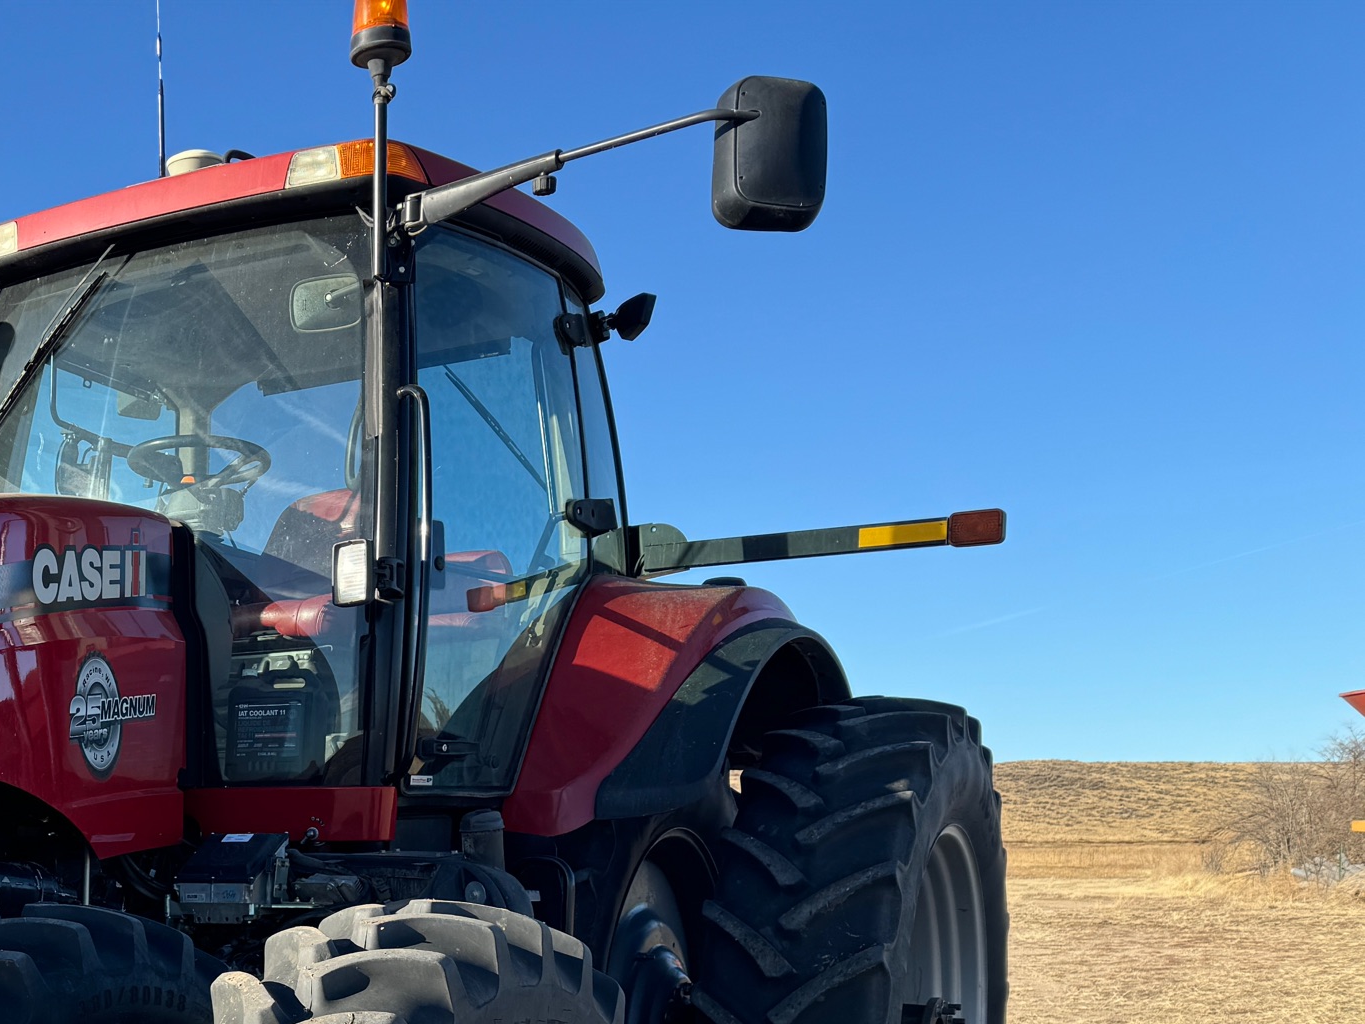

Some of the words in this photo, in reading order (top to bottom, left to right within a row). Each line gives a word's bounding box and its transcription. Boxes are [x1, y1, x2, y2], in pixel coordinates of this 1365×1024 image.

[32, 547, 121, 605] CASE
[69, 693, 102, 740] 25
[100, 694, 156, 721] MAGNUM
[249, 709, 278, 717] COOLANT
[83, 727, 108, 748] years
